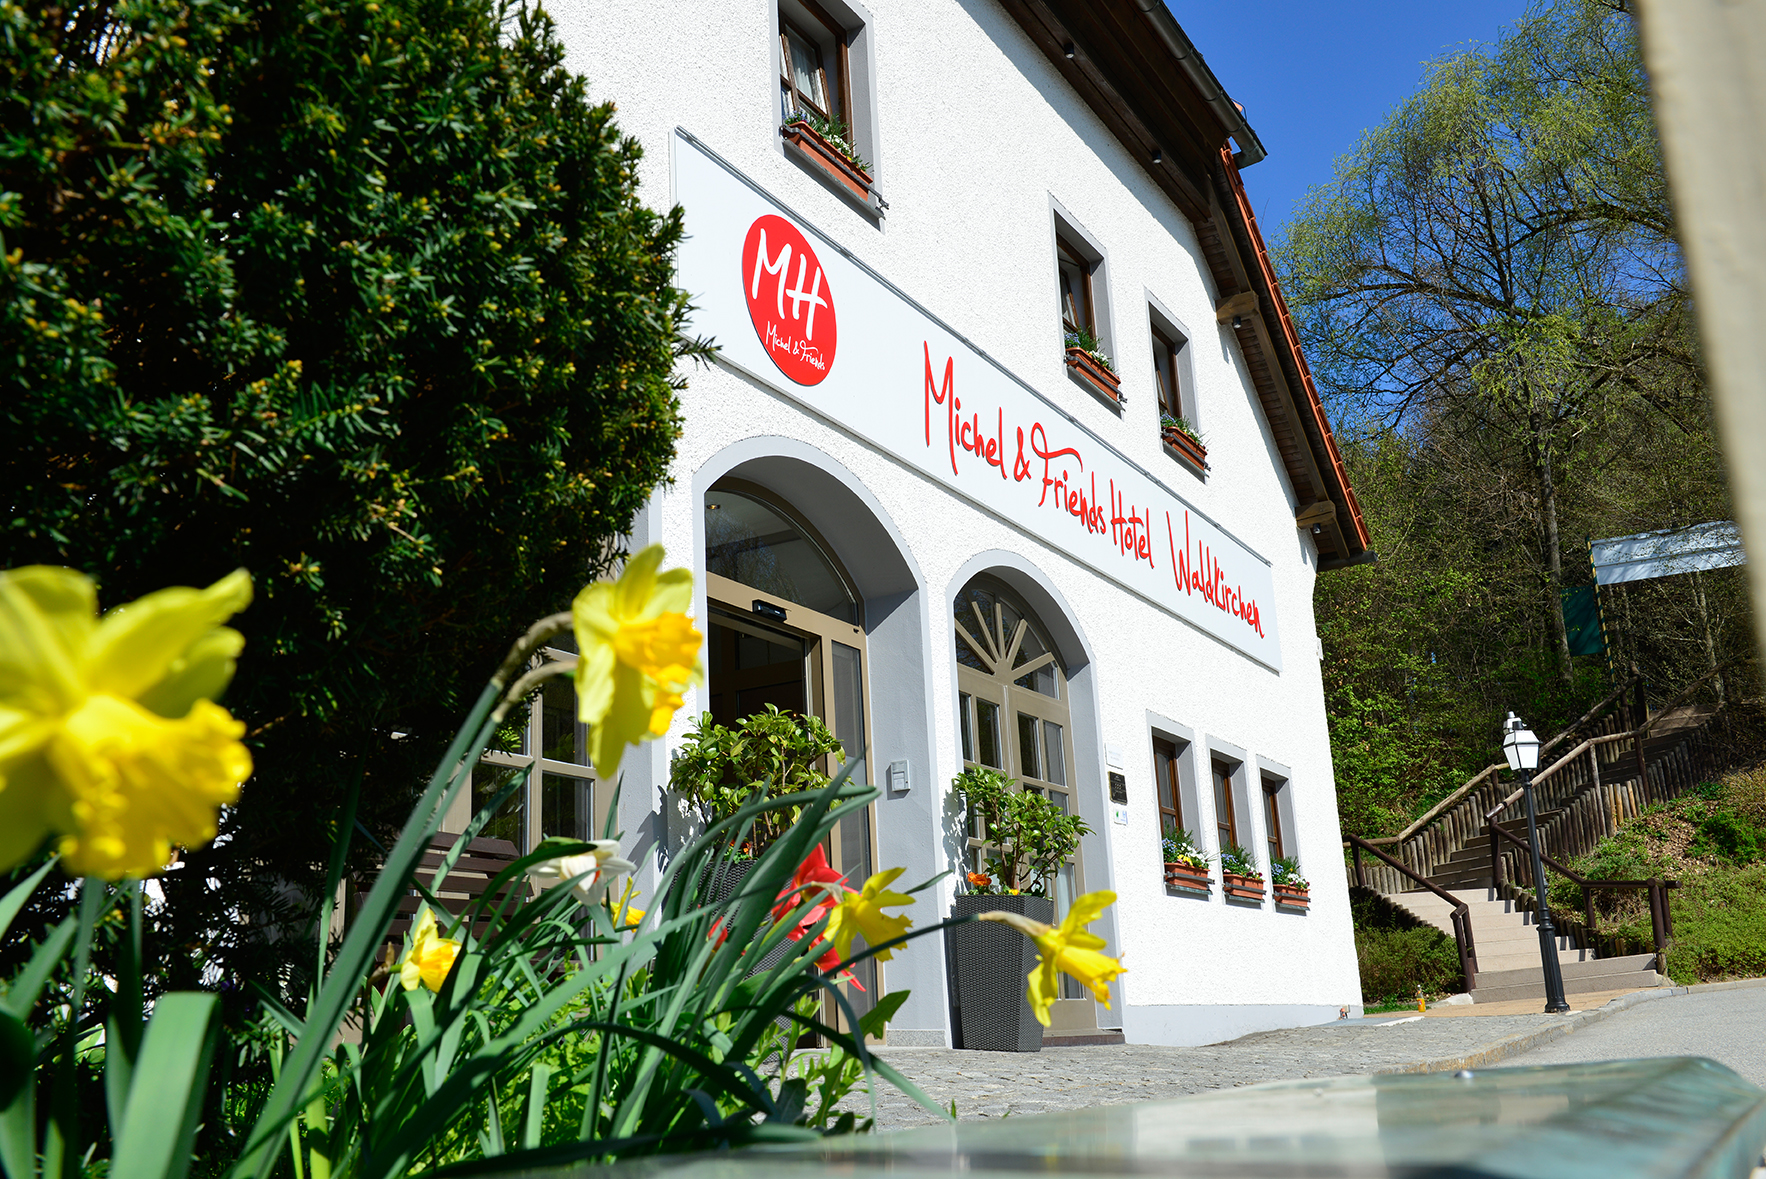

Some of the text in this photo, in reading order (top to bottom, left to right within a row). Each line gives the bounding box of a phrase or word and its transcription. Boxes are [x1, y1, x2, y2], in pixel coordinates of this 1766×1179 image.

[752, 228, 828, 341] MH
[766, 321, 826, 371] Michel & Friends
[924, 340, 1008, 480] Michel
[1014, 426, 1032, 482] &
[1031, 422, 1107, 535] Friends
[1110, 478, 1155, 569] Hotel
